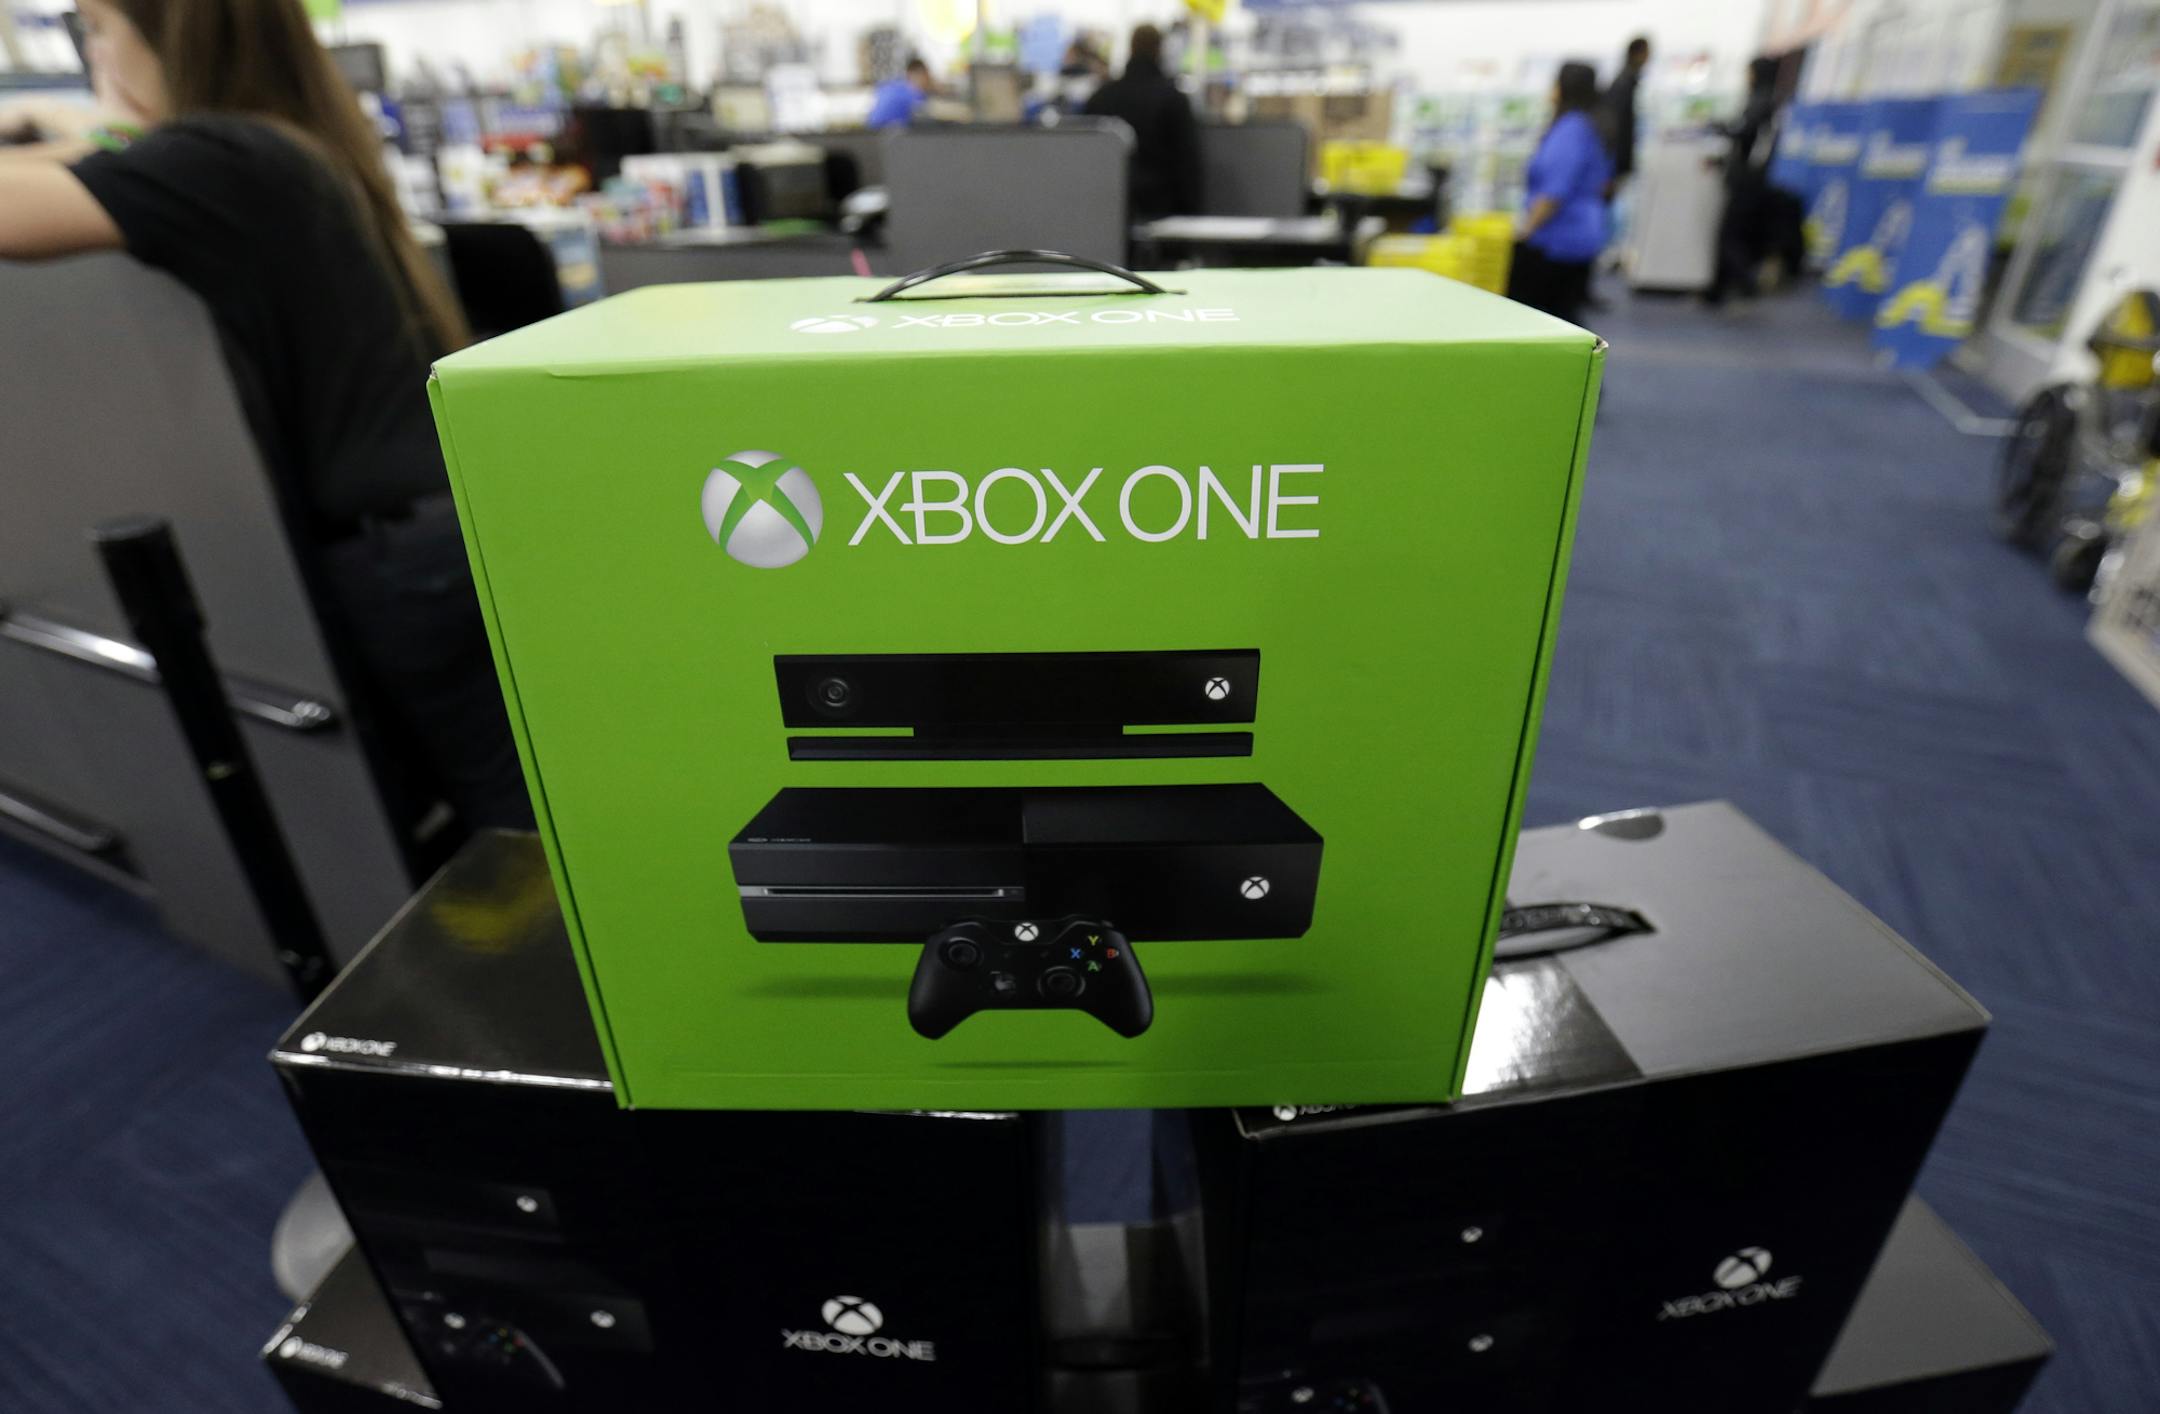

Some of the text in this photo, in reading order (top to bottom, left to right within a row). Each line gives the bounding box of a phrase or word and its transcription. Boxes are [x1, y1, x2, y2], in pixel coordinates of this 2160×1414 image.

[892, 308, 1240, 329] XBOX ONE
[843, 463, 1325, 546] XBOX ONE
[1088, 935, 1099, 946] Y
[1070, 948, 1082, 959] X
[1088, 960, 1099, 971] A
[1656, 1274, 1804, 1322] XBOX ONE
[780, 1327, 937, 1362] XBOX ONE
